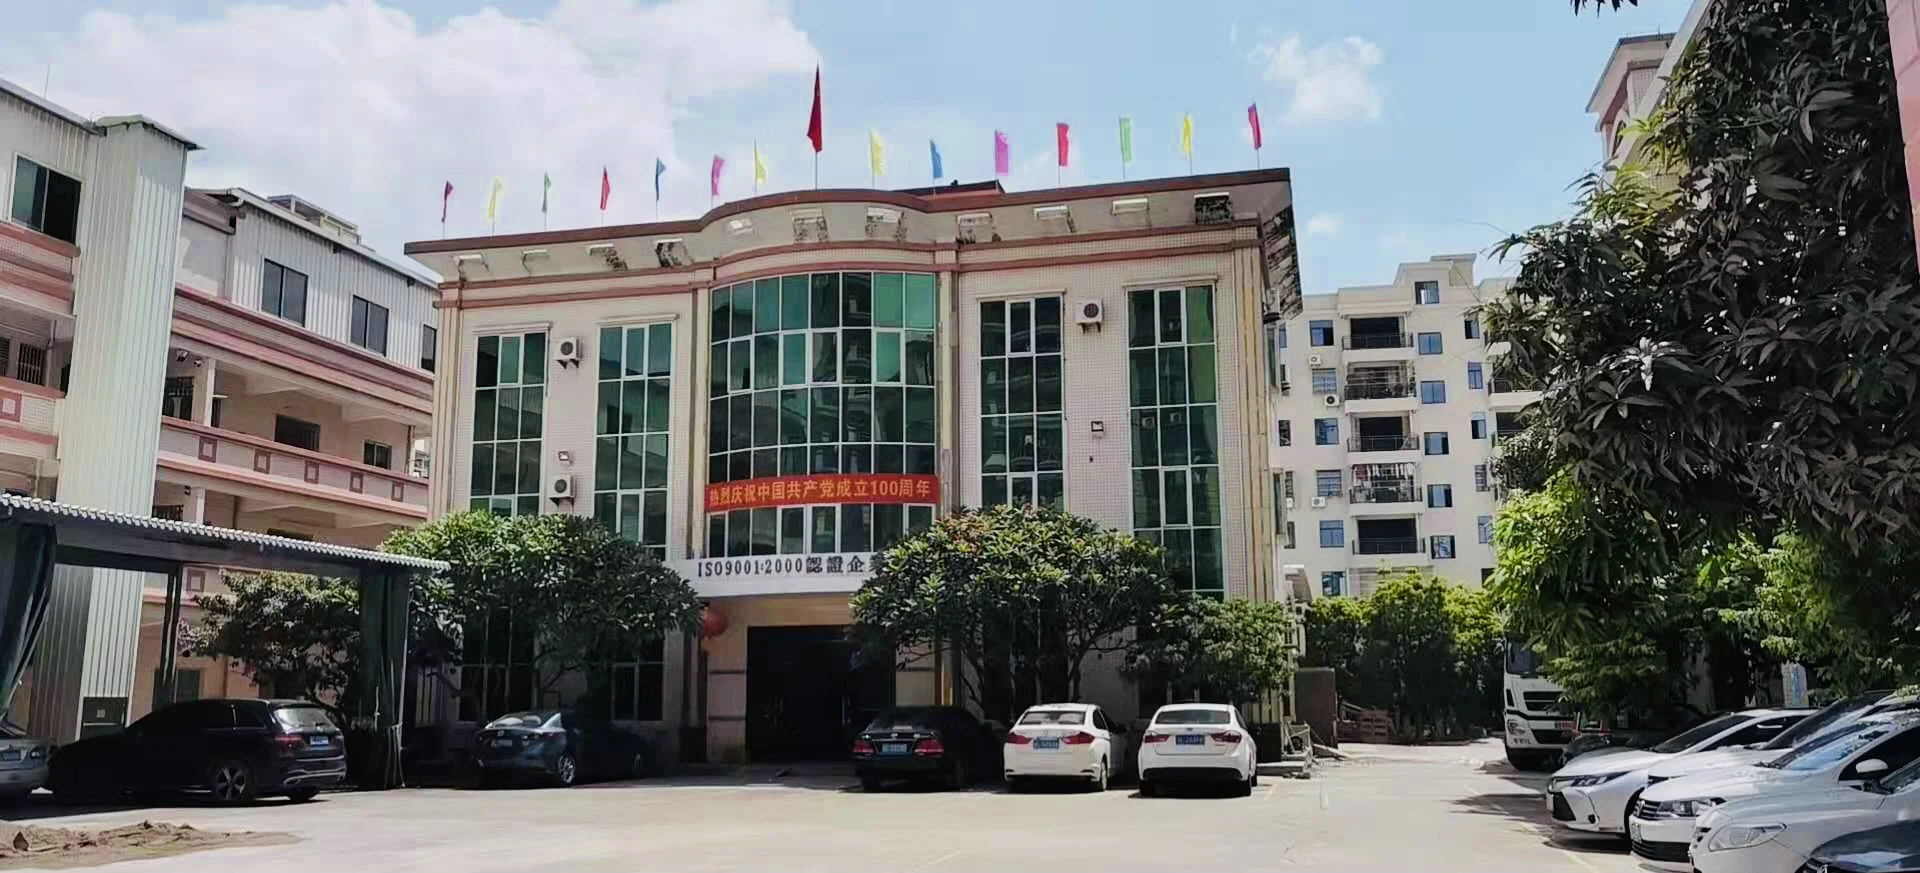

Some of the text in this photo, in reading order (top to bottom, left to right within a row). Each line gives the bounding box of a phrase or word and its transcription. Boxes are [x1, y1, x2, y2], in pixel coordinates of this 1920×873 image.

[710, 479, 931, 506] 热烈庆祝中国共产党成立100周年
